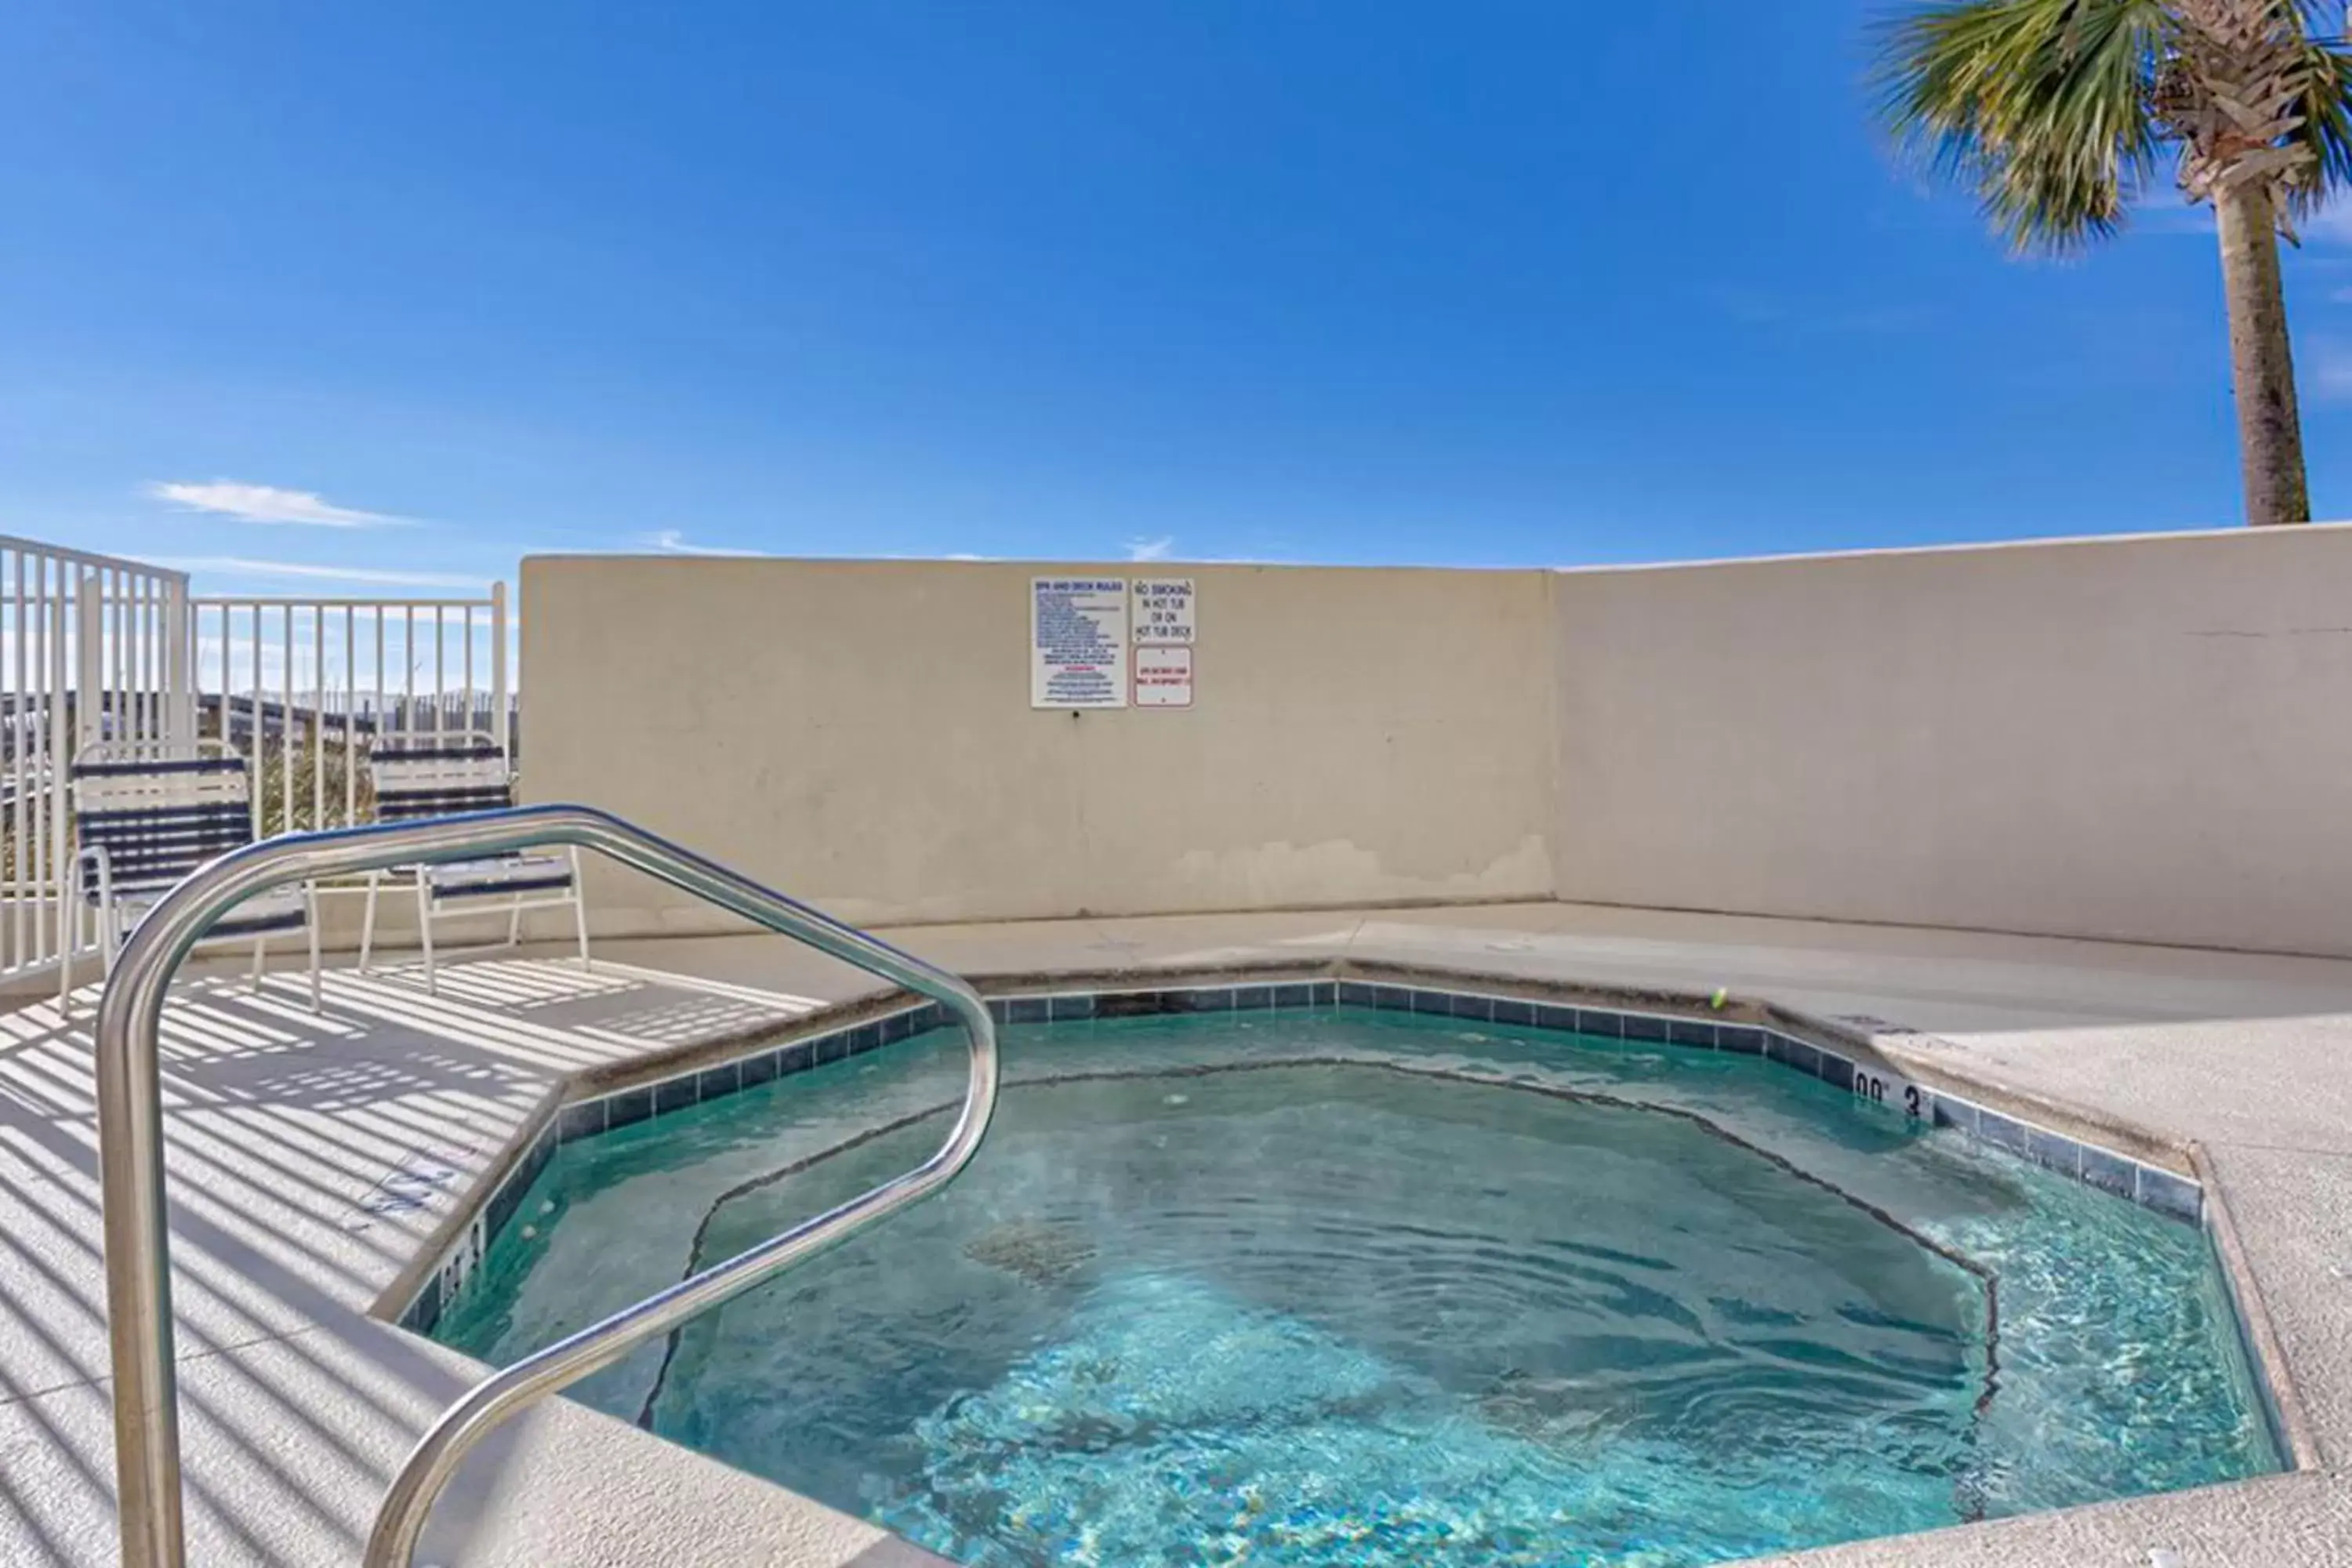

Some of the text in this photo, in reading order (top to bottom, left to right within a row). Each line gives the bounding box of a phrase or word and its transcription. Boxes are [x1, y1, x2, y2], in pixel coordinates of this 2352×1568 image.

[1134, 584, 1192, 596] NO SMOKING
[1142, 597, 1185, 609] IN HOT TUB
[1151, 612, 1177, 624] OR ON
[1136, 625, 1192, 638] HOT TUB DECK
